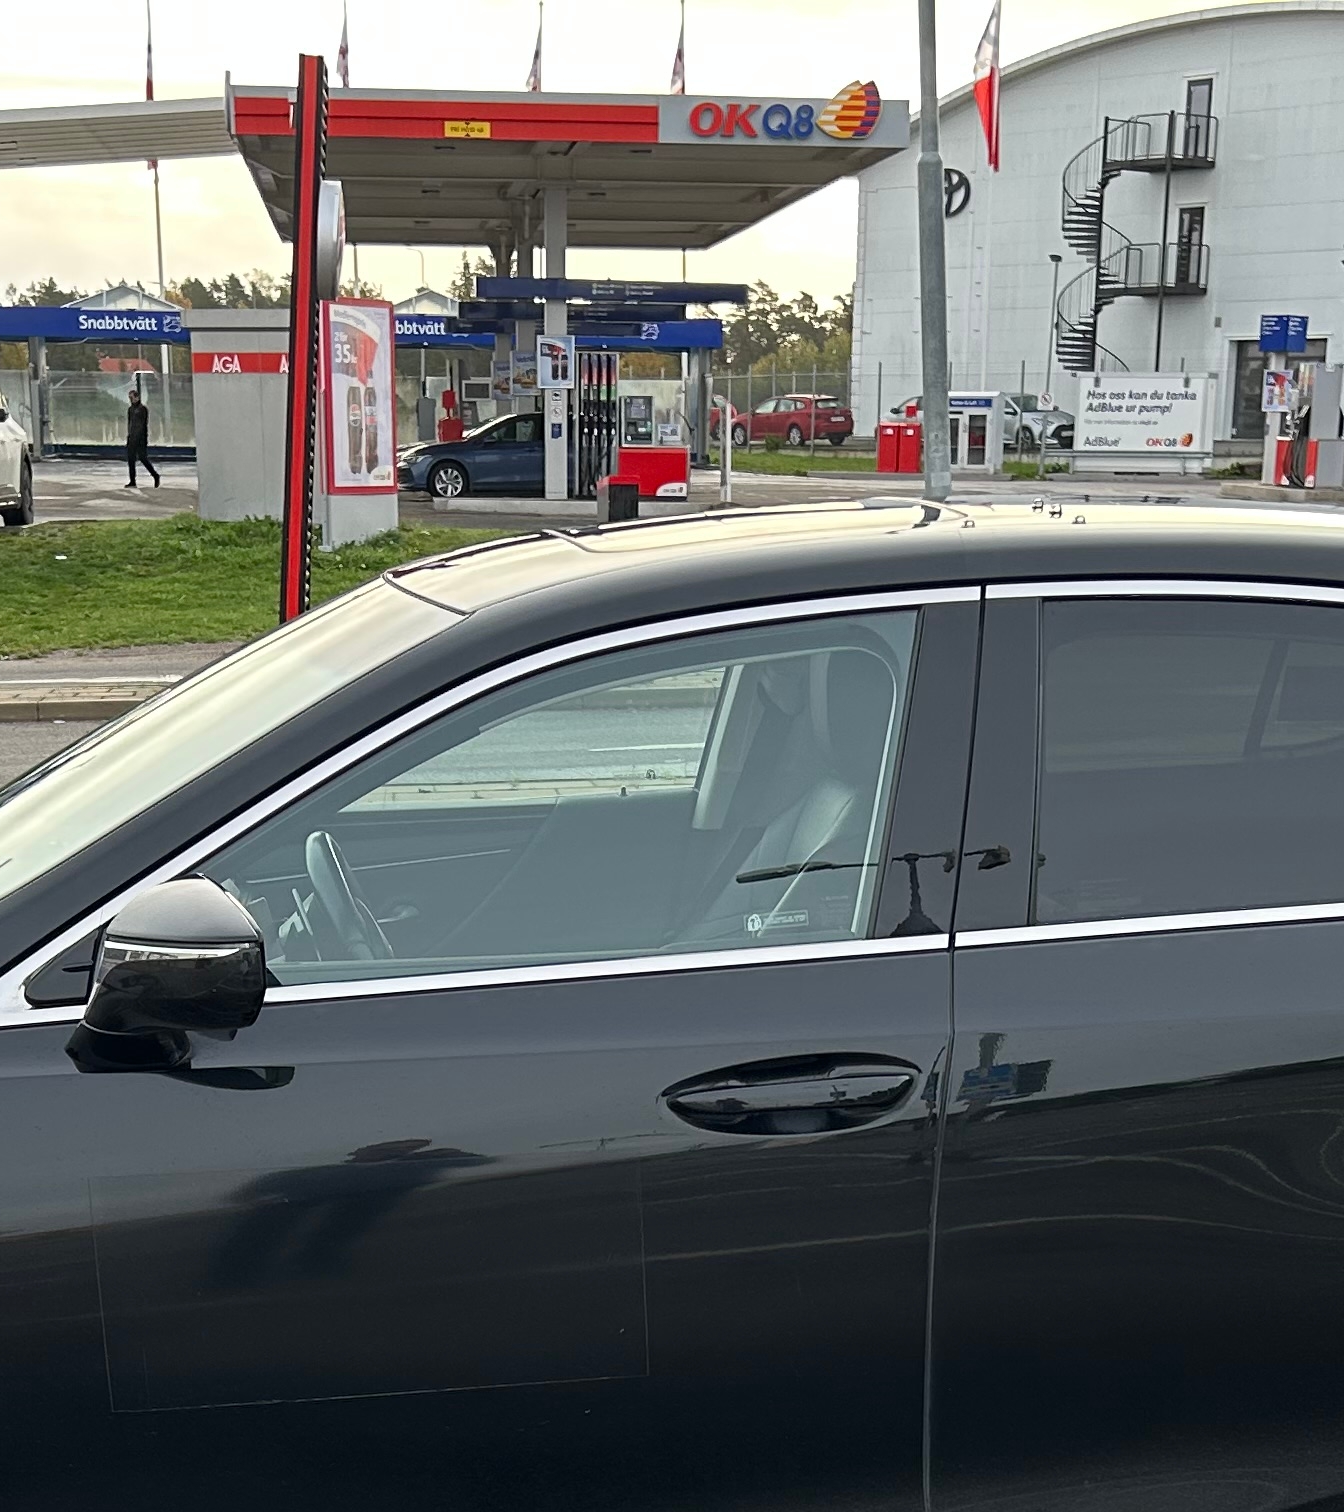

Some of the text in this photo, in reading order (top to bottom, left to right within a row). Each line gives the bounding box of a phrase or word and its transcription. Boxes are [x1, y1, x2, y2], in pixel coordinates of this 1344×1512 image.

[79, 315, 158, 331] Snabbtvätt
[212, 354, 241, 373] AGA
[1086, 390, 1197, 401] Hos oss kan du tanka
[1085, 402, 1173, 415] AdBlue ur pump!
